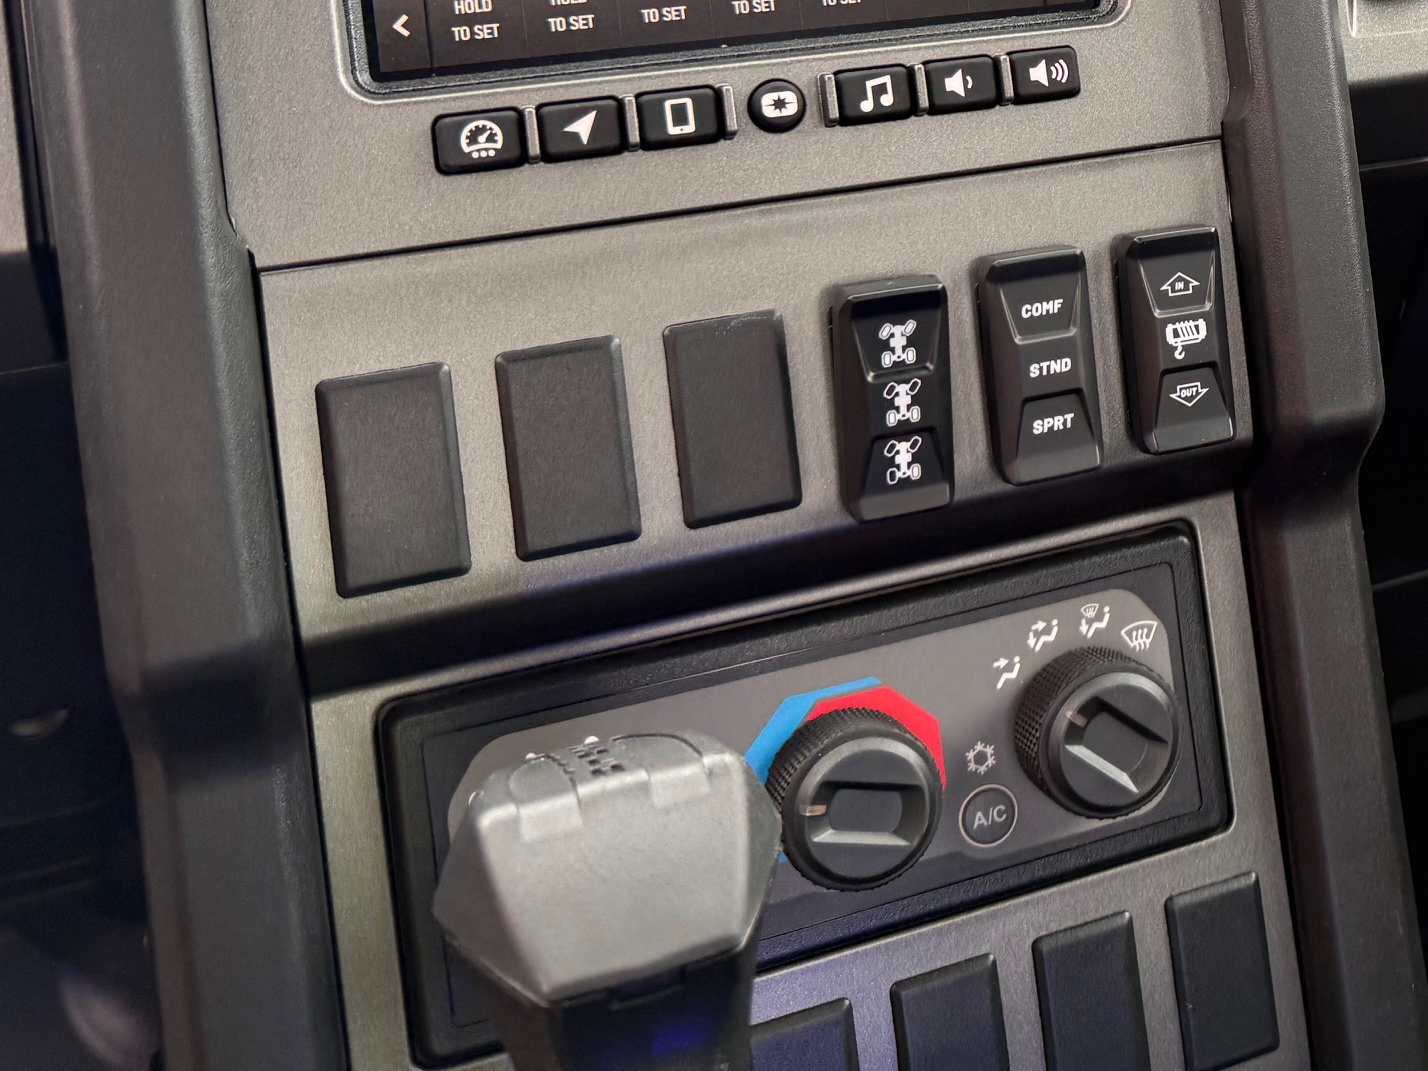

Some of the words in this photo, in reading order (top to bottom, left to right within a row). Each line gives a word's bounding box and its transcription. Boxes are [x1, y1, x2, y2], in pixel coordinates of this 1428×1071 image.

[640, 8, 659, 24] TO
[662, 6, 688, 21] SET
[732, 0, 750, 15] TO
[452, 26, 470, 42] TO
[474, 23, 500, 40] SET
[548, 17, 566, 33] TO
[569, 14, 595, 31] SET
[1174, 281, 1185, 291] IN
[1021, 298, 1064, 319] COMF
[1029, 357, 1072, 378] STND
[1180, 387, 1198, 398] OUT
[1032, 413, 1075, 435] SPRT
[973, 804, 1008, 830] A/C
